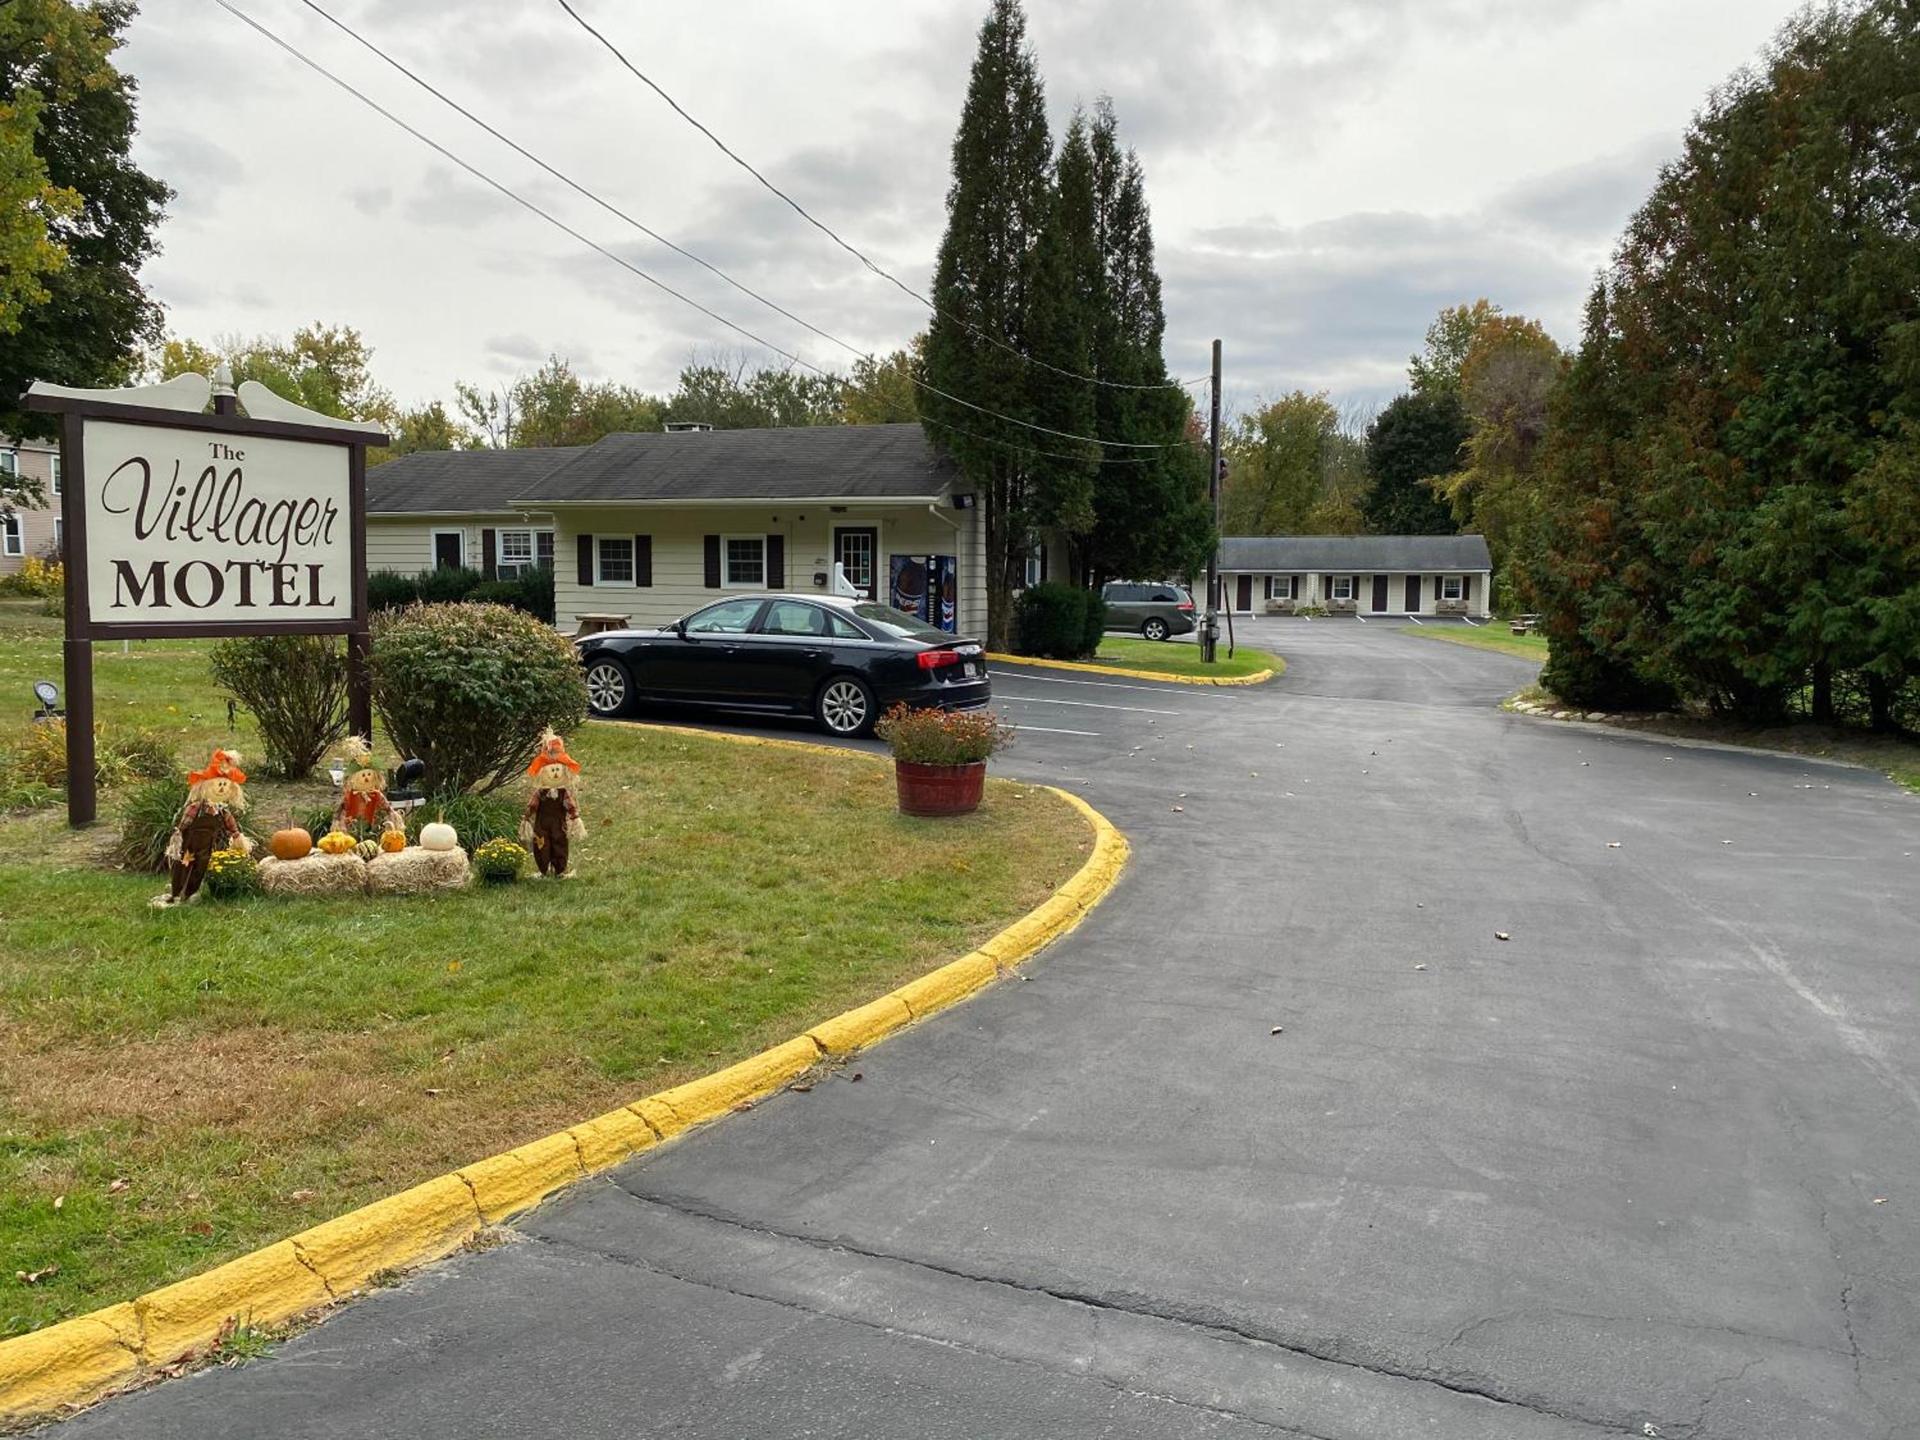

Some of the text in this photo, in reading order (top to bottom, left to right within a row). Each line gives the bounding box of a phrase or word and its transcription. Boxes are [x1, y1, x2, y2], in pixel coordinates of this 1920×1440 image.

[208, 442, 245, 462] The
[101, 456, 339, 564] Villager
[110, 559, 336, 609] MOTEL
